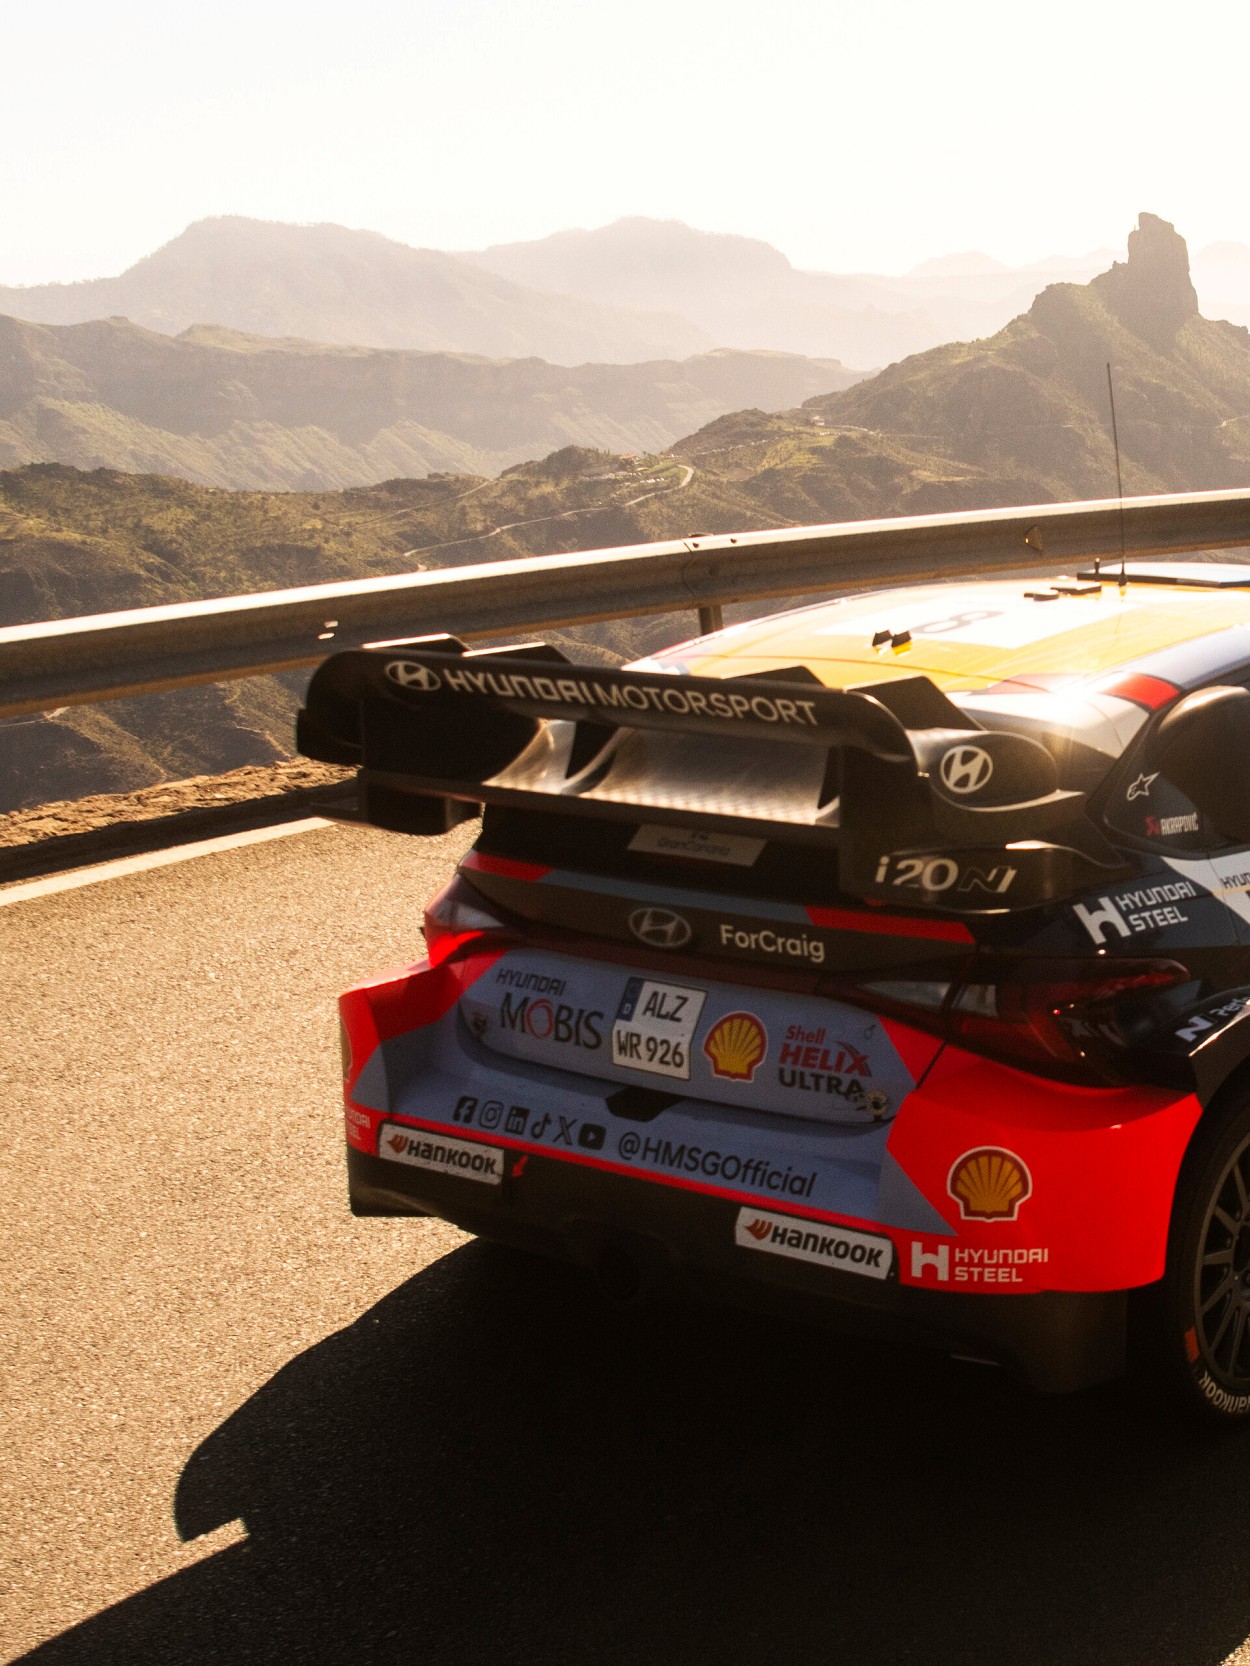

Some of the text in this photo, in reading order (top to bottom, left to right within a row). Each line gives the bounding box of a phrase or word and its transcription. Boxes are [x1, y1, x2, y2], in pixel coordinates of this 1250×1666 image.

[444, 669, 816, 726] HYUNDAI MOTORSPORT
[874, 855, 960, 892] i20
[1116, 881, 1198, 912] HYUNDAI
[1128, 905, 1190, 933] STEEL
[719, 924, 826, 963] ForCraig
[496, 968, 567, 997] HYUNDAI
[500, 992, 605, 1050] MOBIS
[643, 990, 689, 1023] ALZ
[616, 1029, 685, 1068] WR 926
[785, 1024, 827, 1045] Shell
[779, 1041, 873, 1079] HELIX
[778, 1067, 866, 1104] ULTRA
[618, 1131, 818, 1198] @HMSGOfficial
[954, 1248, 1049, 1264] HYUNDAI
[954, 1266, 1023, 1283] STEEL
